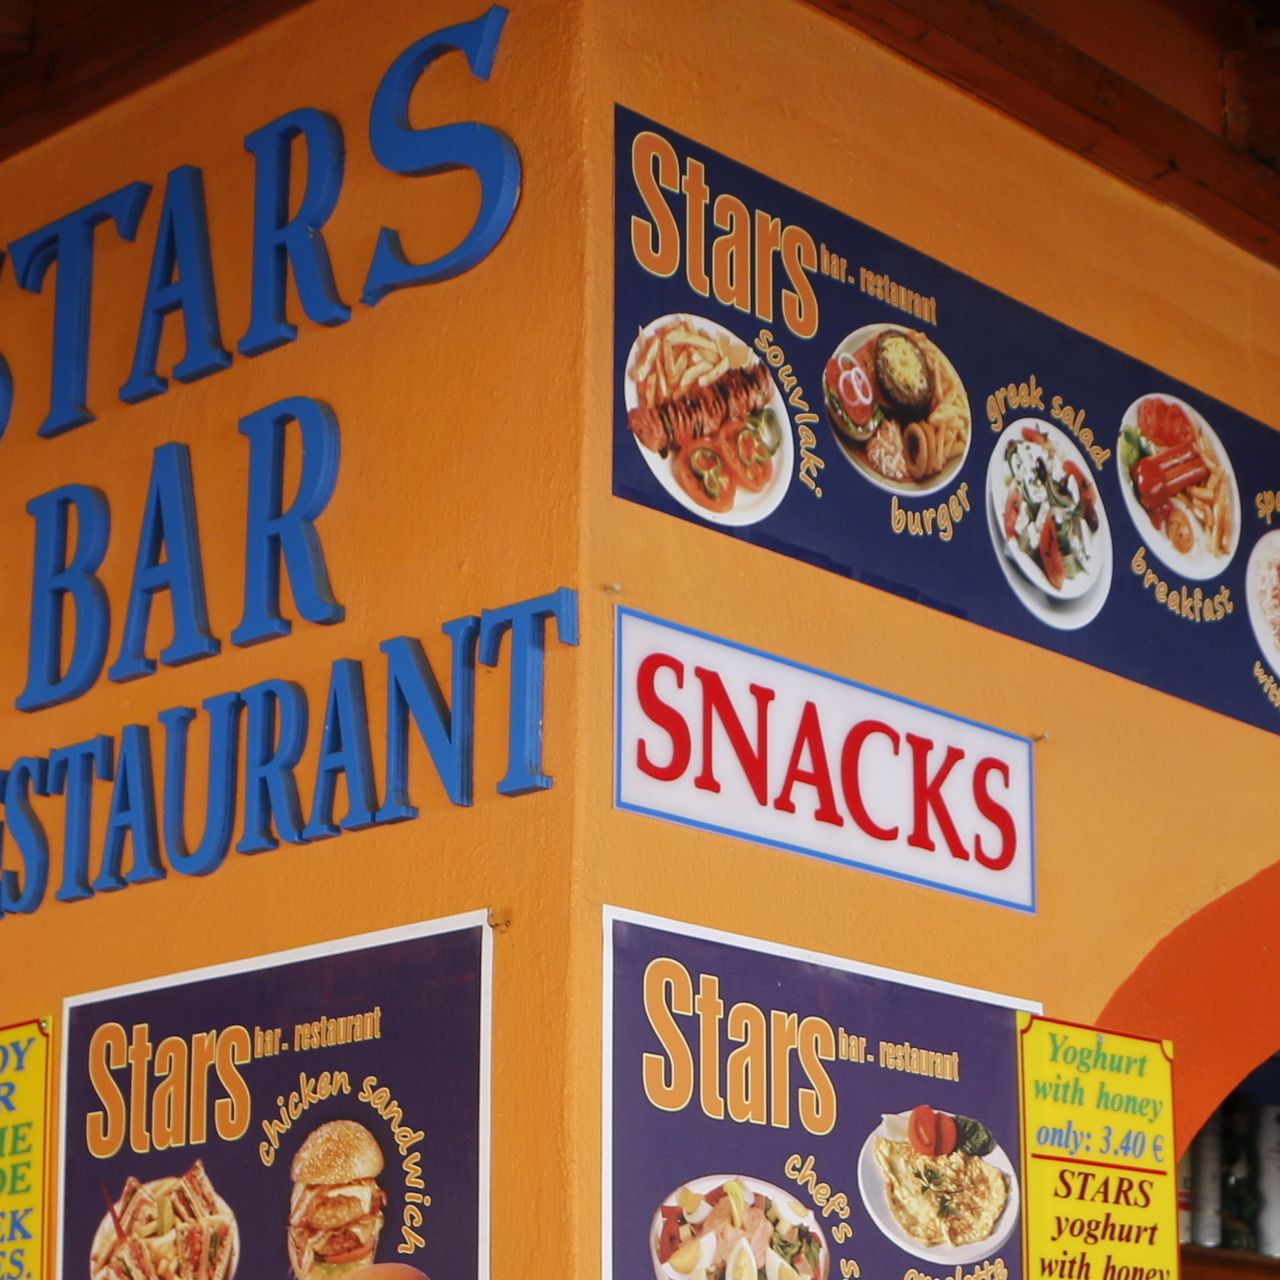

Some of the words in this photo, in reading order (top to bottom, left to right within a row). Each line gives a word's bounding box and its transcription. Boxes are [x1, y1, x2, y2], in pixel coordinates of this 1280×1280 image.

[631, 131, 818, 339] Stars
[860, 267, 937, 326] restaurant
[755, 329, 825, 498] souvlaki
[986, 375, 1045, 433] greek
[1051, 394, 1111, 470] salad
[16, 396, 345, 711] BAR
[891, 482, 972, 542] burger
[1132, 547, 1234, 623] breakfast
[637, 653, 1017, 870] SNACKS
[86, 1022, 251, 1158] Stars
[294, 1007, 381, 1051] restaurant
[643, 957, 837, 1135] Stars
[879, 1040, 960, 1082] restaurant
[1048, 1033, 1148, 1078] Yoghurt
[1033, 1075, 1085, 1106] with
[1096, 1082, 1163, 1122] honey
[1037, 1121, 1091, 1156] only:
[1099, 1126, 1146, 1159] 3.40
[1152, 1134, 1165, 1162] €
[259, 1070, 351, 1167] chicken
[358, 1075, 431, 1255] sandwich
[785, 1154, 852, 1244] chef's
[1054, 1169, 1153, 1208] STARS
[1040, 1251, 1091, 1280] with
[1052, 1214, 1158, 1245] yoghurt
